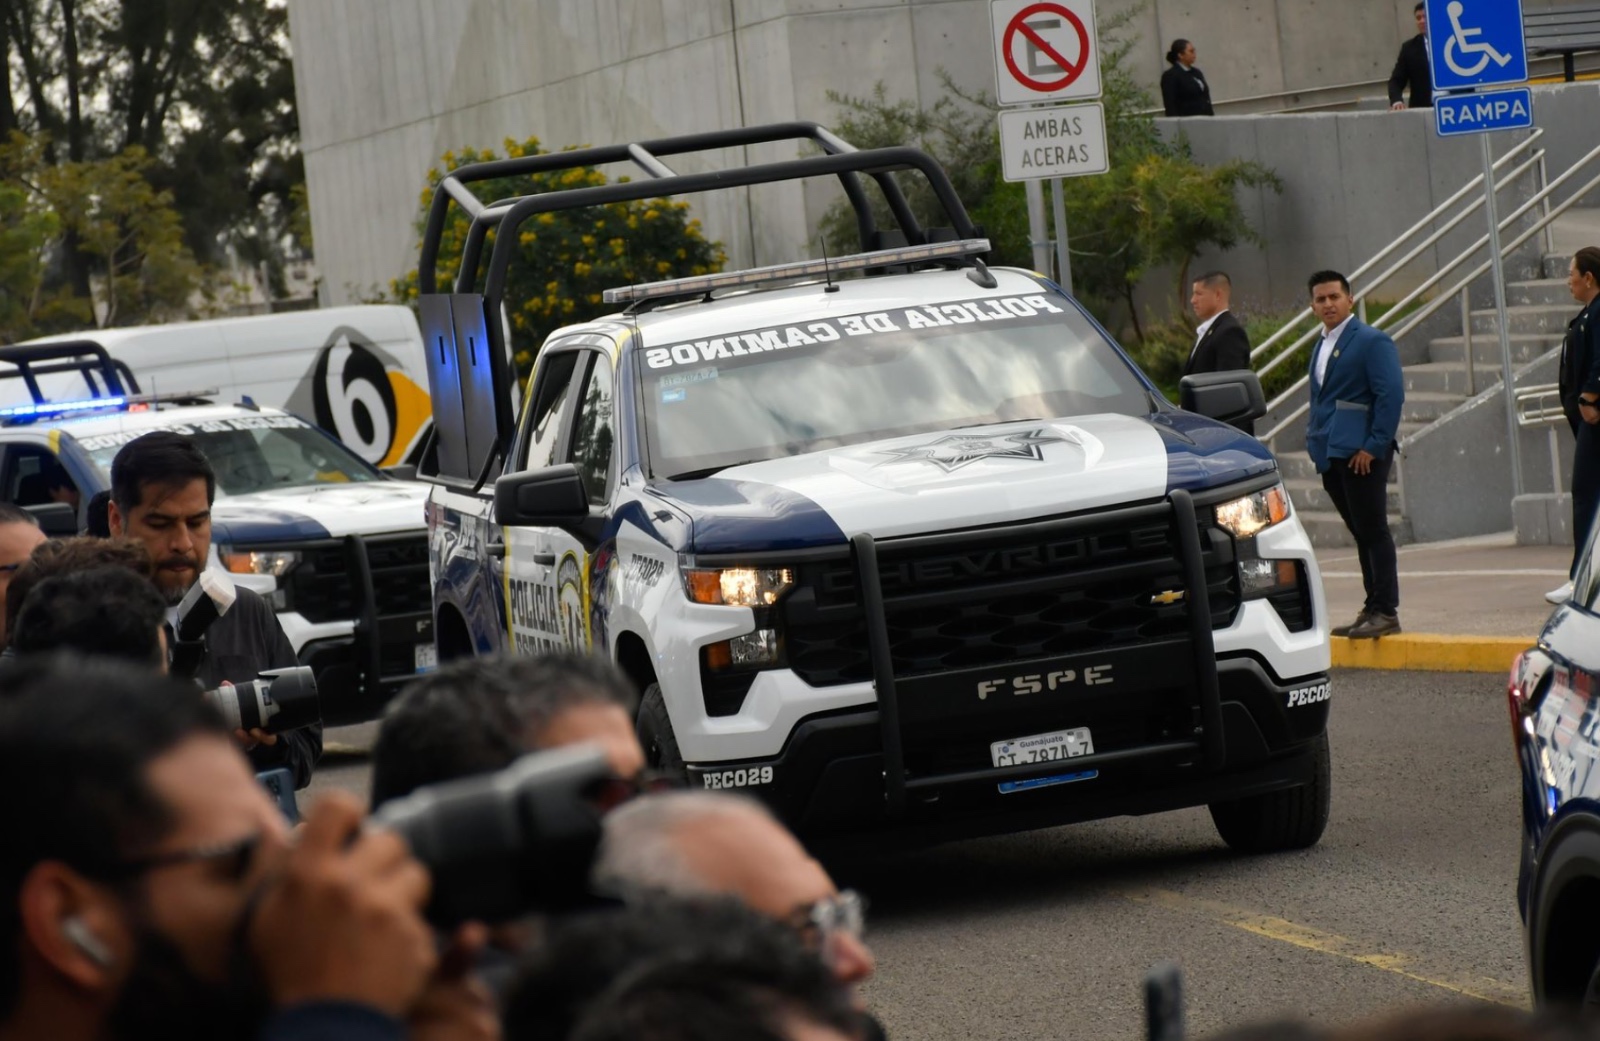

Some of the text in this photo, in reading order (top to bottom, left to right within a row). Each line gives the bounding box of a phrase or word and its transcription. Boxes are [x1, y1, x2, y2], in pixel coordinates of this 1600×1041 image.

[1440, 99, 1527, 125] RAMPA
[1024, 117, 1083, 140] AMBAS
[1022, 144, 1089, 168] ACERAS
[325, 334, 391, 465] 6
[819, 524, 1173, 594] CHEVROLE
[977, 664, 1114, 700] FSPE
[1019, 735, 1064, 748] Guanajuato
